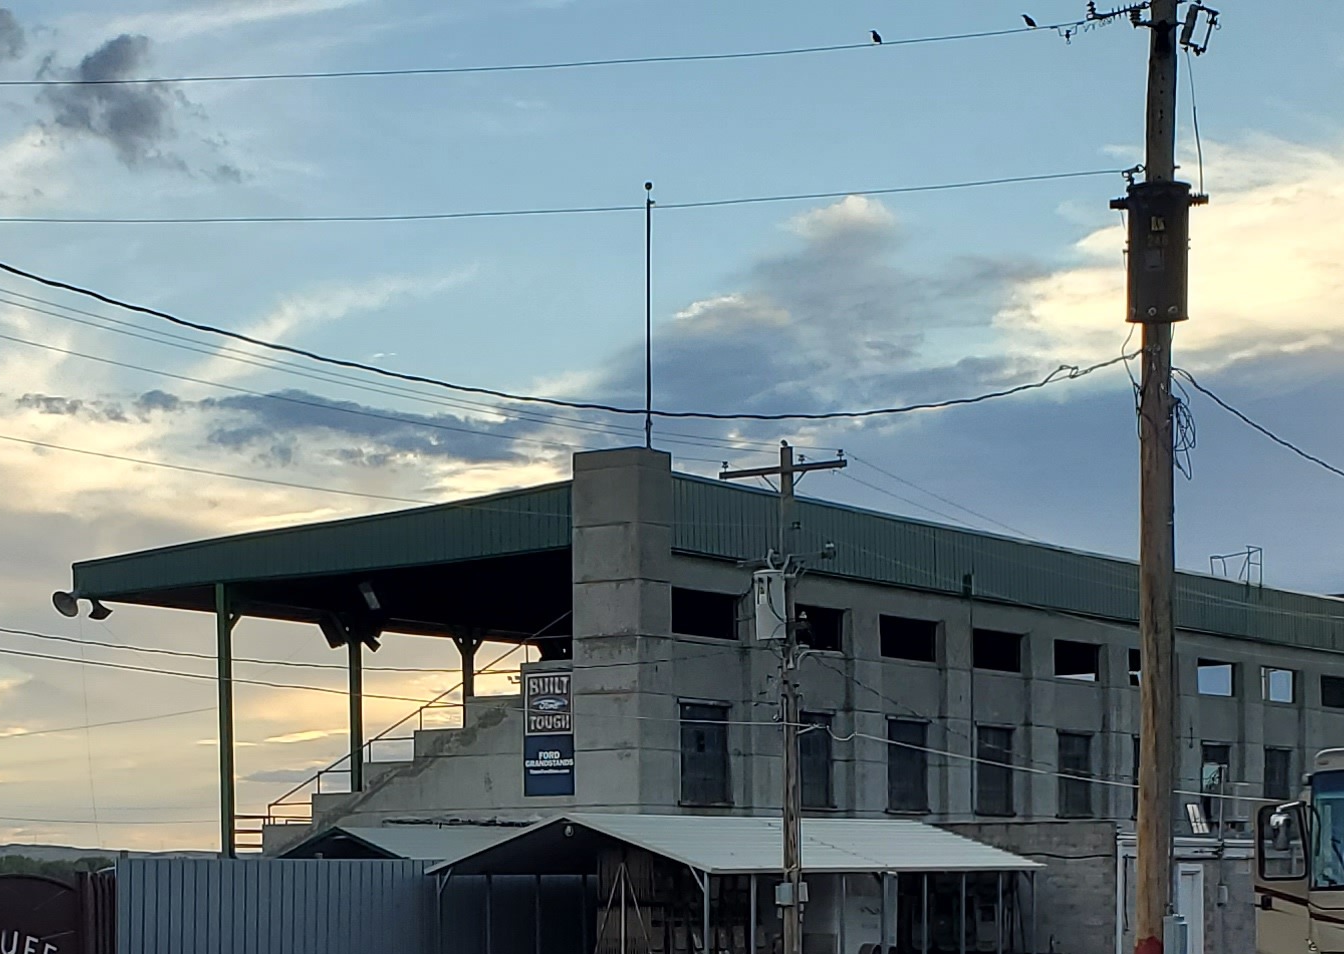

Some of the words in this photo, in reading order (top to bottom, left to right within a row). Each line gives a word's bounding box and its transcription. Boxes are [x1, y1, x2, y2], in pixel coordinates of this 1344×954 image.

[529, 676, 569, 696] BUILT
[529, 715, 570, 730] TOUGH
[538, 751, 560, 760] FORD
[525, 759, 574, 767] GRANDSTANDS
